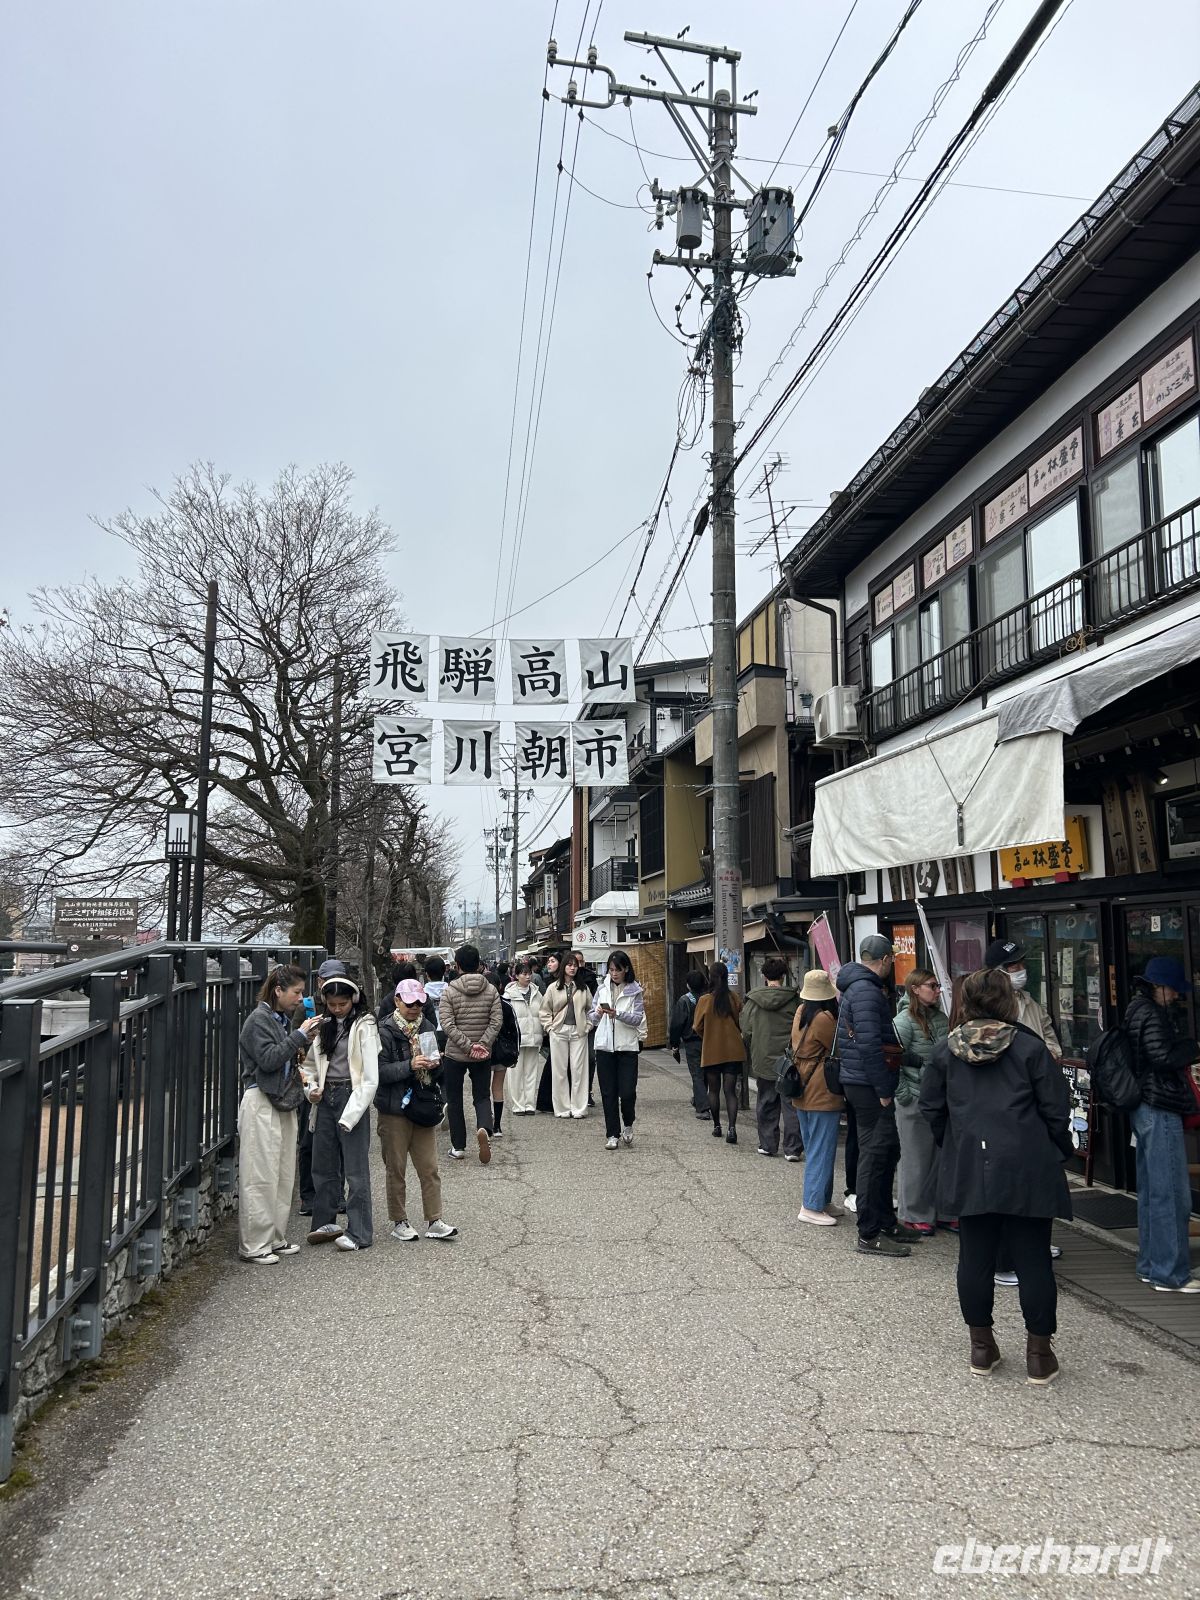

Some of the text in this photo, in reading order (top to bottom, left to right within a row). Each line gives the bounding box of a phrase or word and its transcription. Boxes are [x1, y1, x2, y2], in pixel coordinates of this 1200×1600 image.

[1033, 437, 1079, 488] 高山林盛堂
[373, 640, 629, 697] 飛騨高山
[377, 725, 623, 780] 宮川朝市
[1014, 840, 1073, 872] 高山林盛堂
[589, 929, 609, 943] 泉屋
